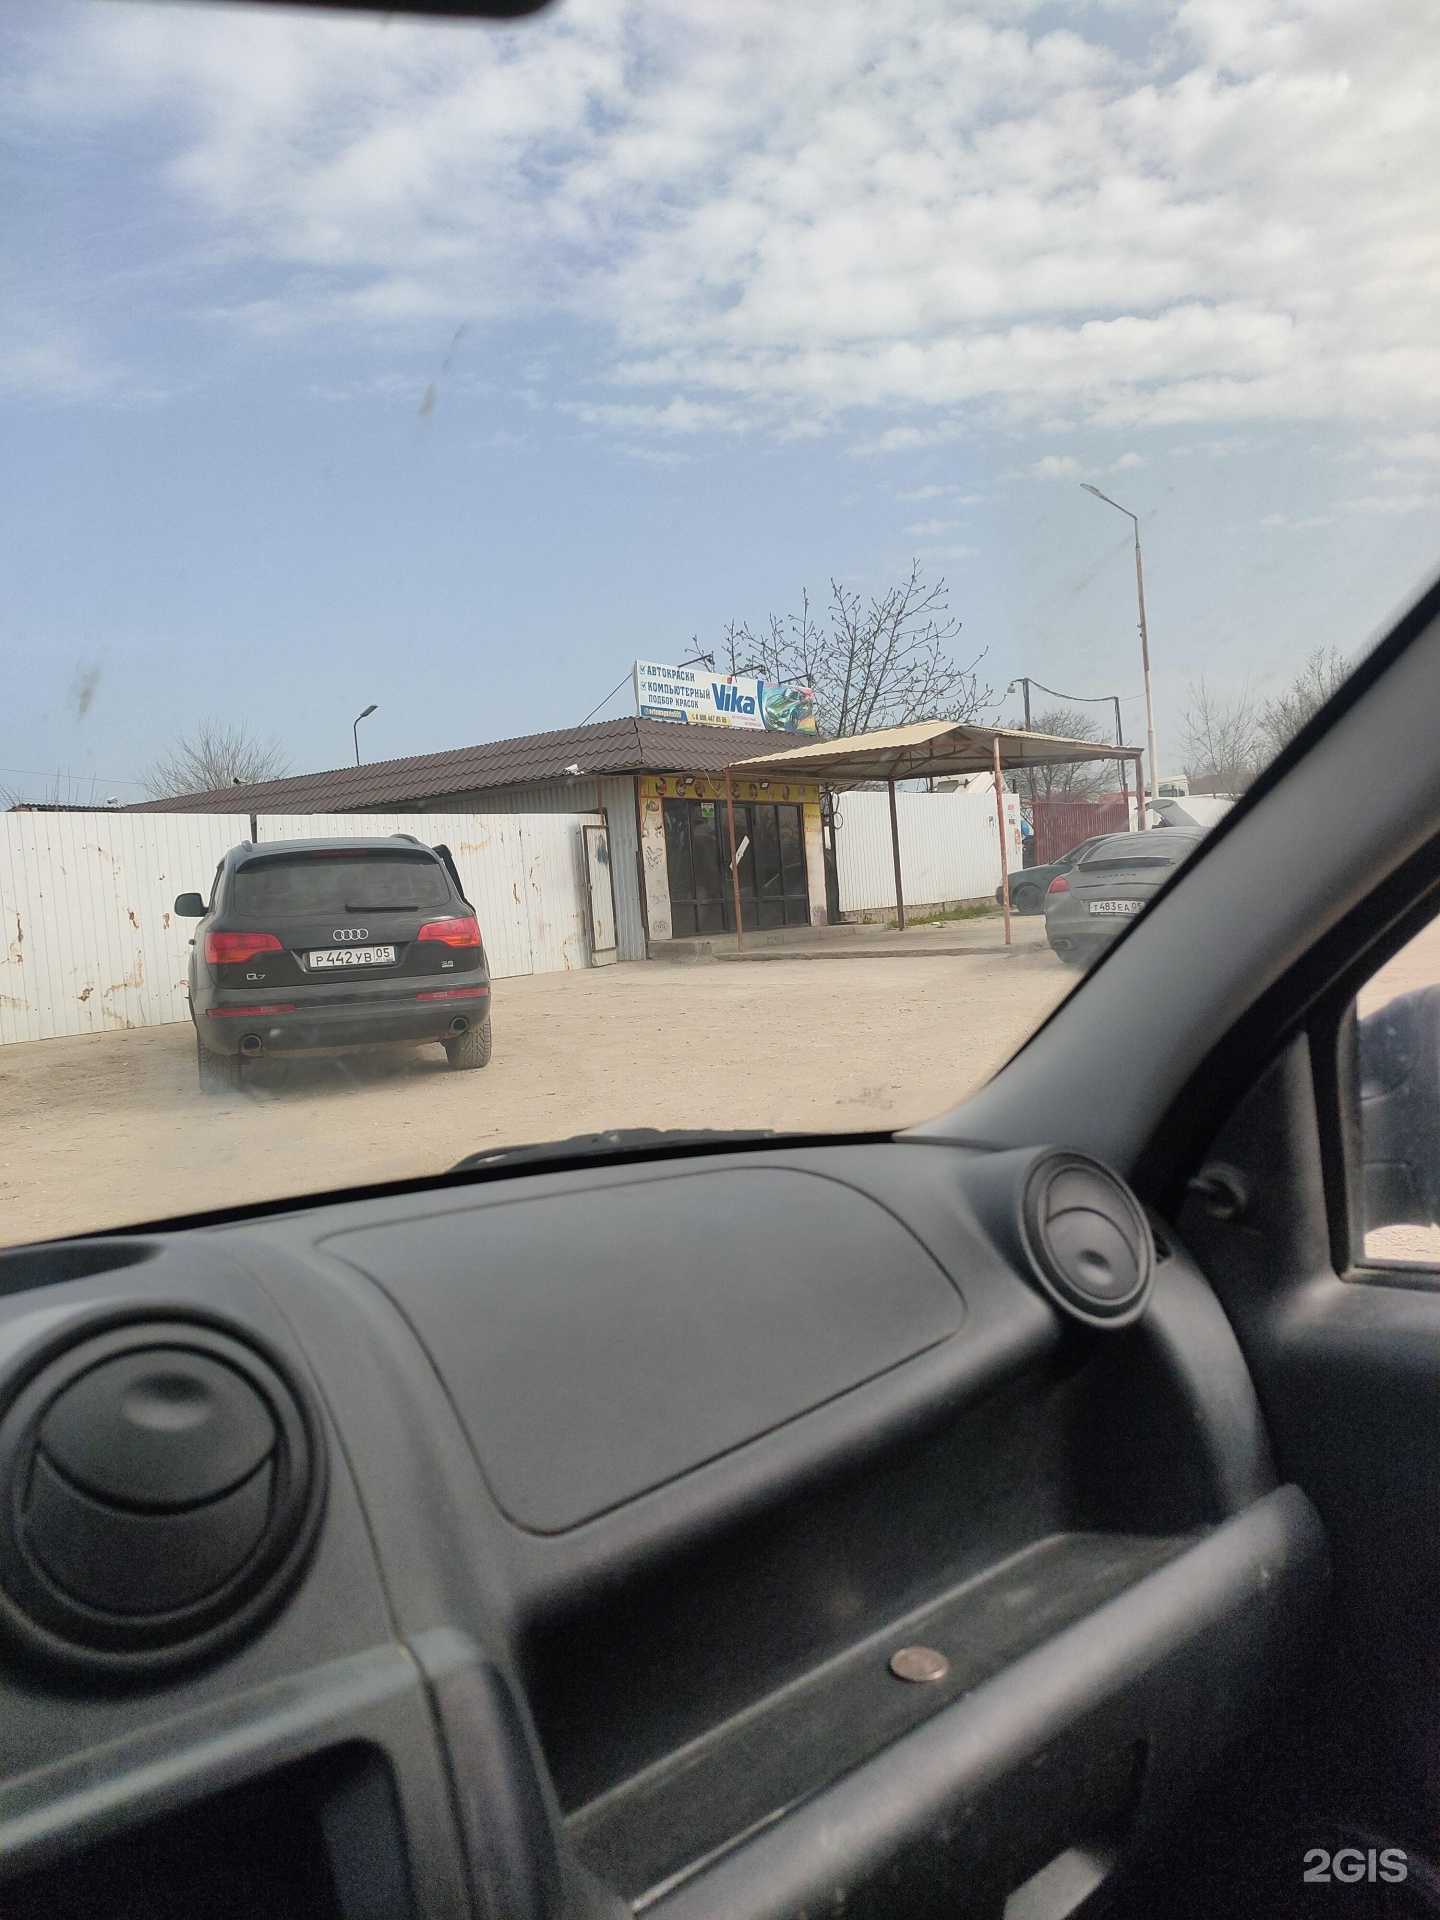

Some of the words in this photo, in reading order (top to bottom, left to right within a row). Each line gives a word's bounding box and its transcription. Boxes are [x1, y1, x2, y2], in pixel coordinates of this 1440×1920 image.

[647, 665, 695, 682] АВТОКРАСКИ
[647, 681, 711, 699] КОМПЬЮТЕРНЫЙ
[648, 694, 674, 706] ПОДБОР
[675, 697, 700, 708] КРАСОК
[711, 683, 756, 715] Vika
